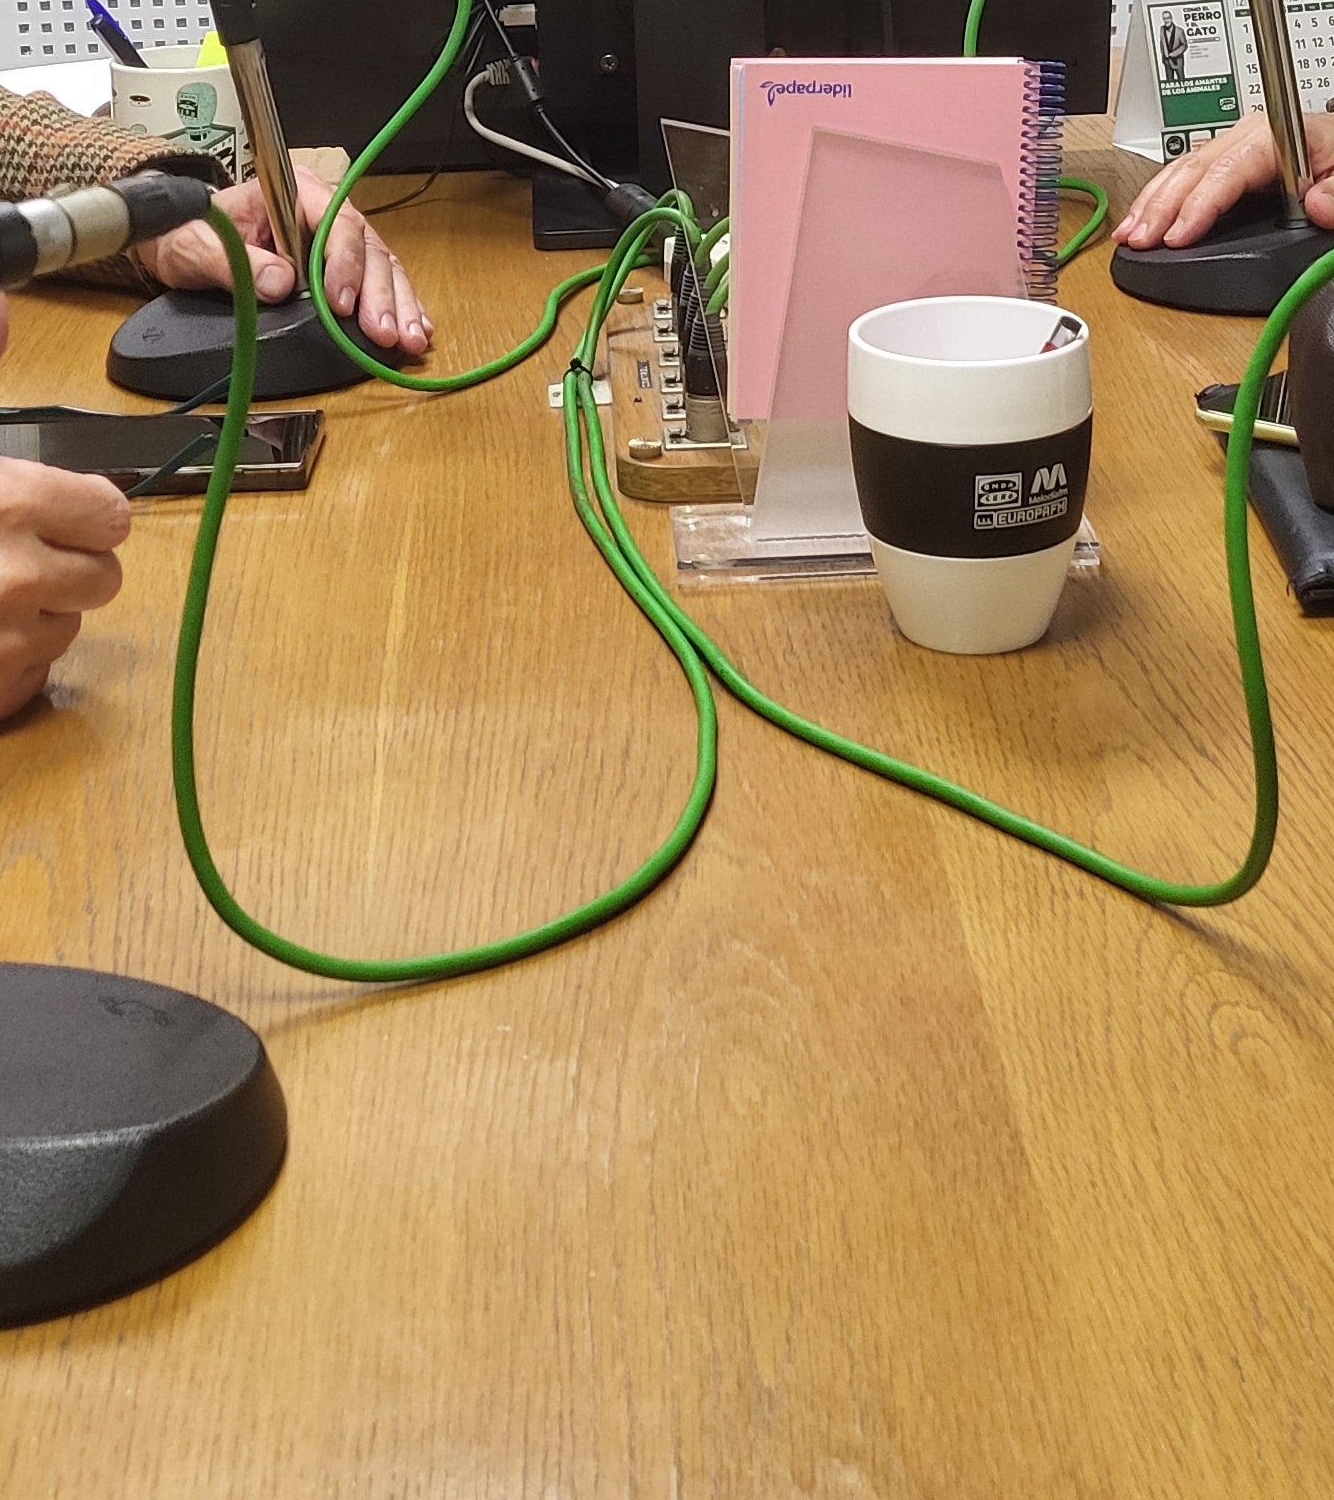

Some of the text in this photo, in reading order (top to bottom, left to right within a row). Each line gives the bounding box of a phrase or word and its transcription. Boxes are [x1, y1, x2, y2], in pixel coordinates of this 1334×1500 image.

[1184, 11, 1222, 22] PERRO
[1187, 26, 1217, 37] GATO
[1243, 24, 1249, 33] 1
[1294, 19, 1302, 29] 4
[1311, 17, 1318, 27] 5
[1245, 44, 1253, 53] 8
[1295, 39, 1306, 49] 11
[1312, 37, 1324, 47] 12
[1246, 64, 1258, 74] 15
[1297, 59, 1310, 69] 18
[1315, 57, 1327, 67] 19
[1160, 77, 1227, 88] PARA LOS AMANTES
[1248, 84, 1261, 94] 22
[1300, 79, 1313, 89] 25
[1317, 77, 1330, 88] 26
[760, 80, 852, 107] liderpapel
[983, 482, 1014, 490] ONDA
